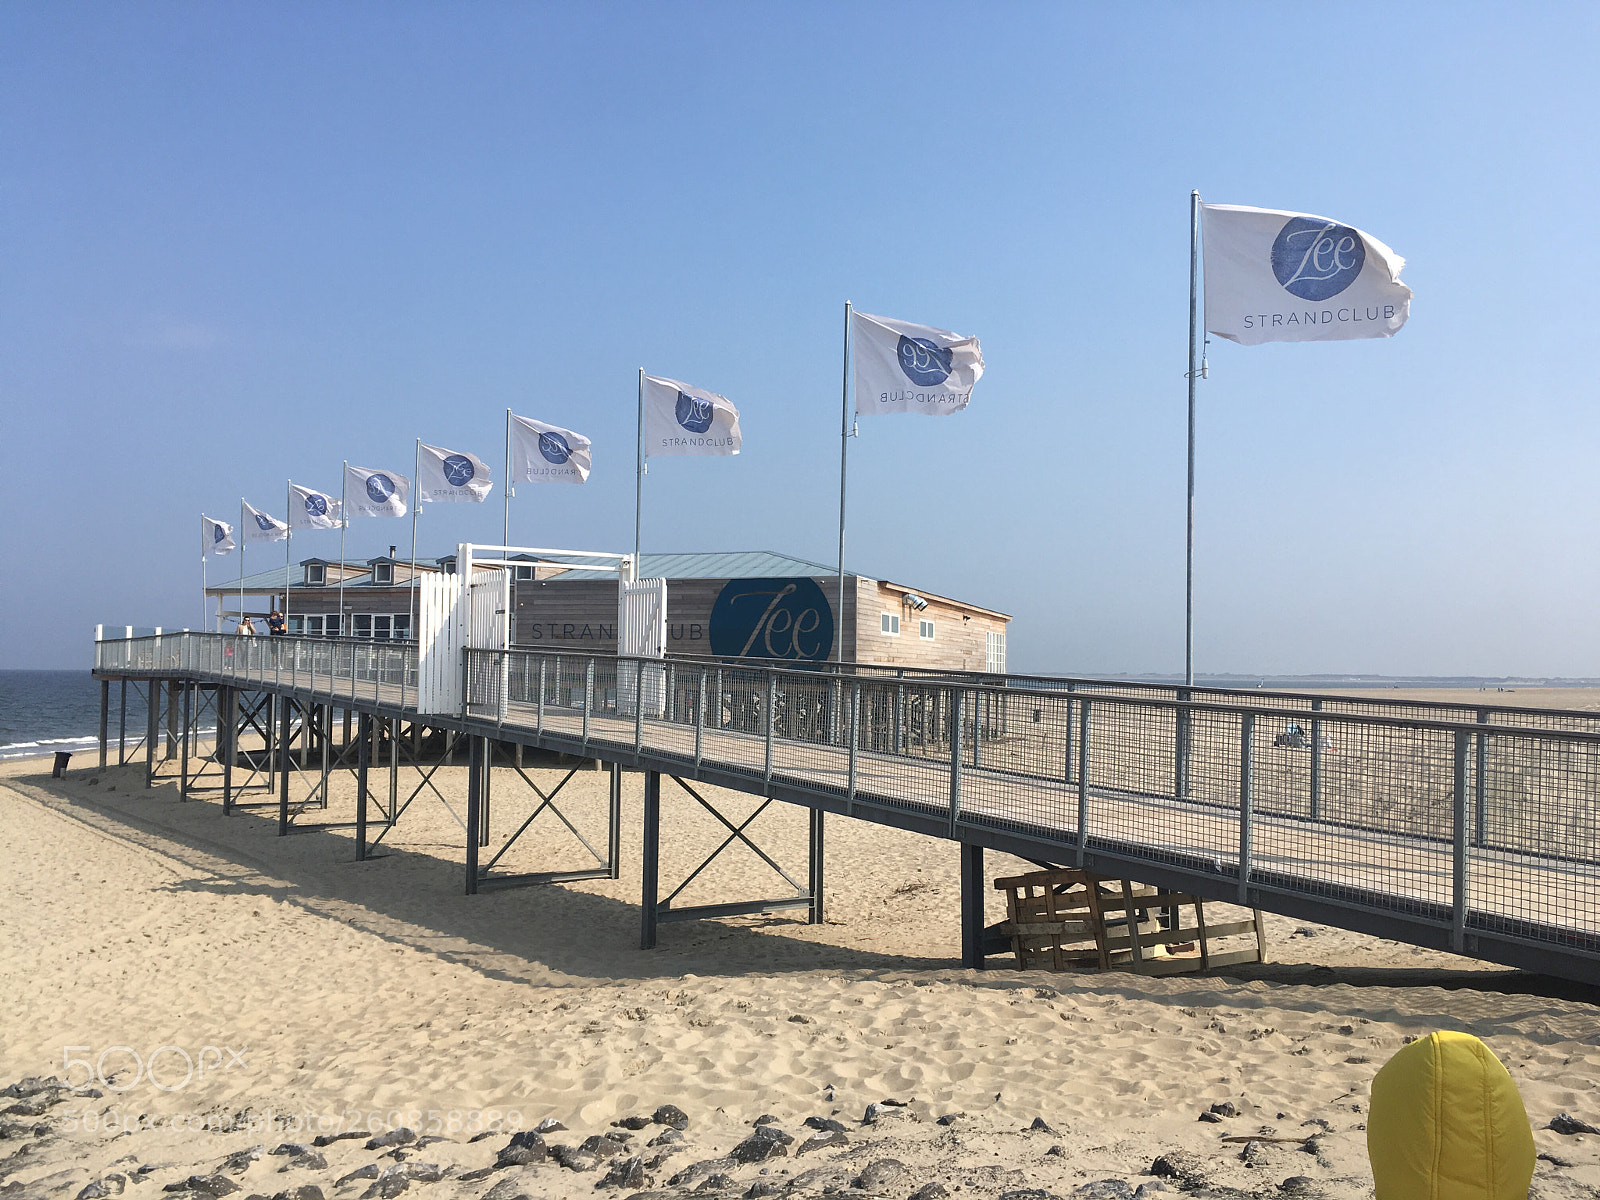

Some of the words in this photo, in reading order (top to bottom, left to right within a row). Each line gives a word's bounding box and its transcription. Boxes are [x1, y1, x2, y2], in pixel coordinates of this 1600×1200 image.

[1283, 222, 1356, 288] Zee
[1243, 305, 1396, 329] STRANDCLUB
[662, 438, 734, 447] STRANDCLUB
[730, 583, 820, 665] Zee
